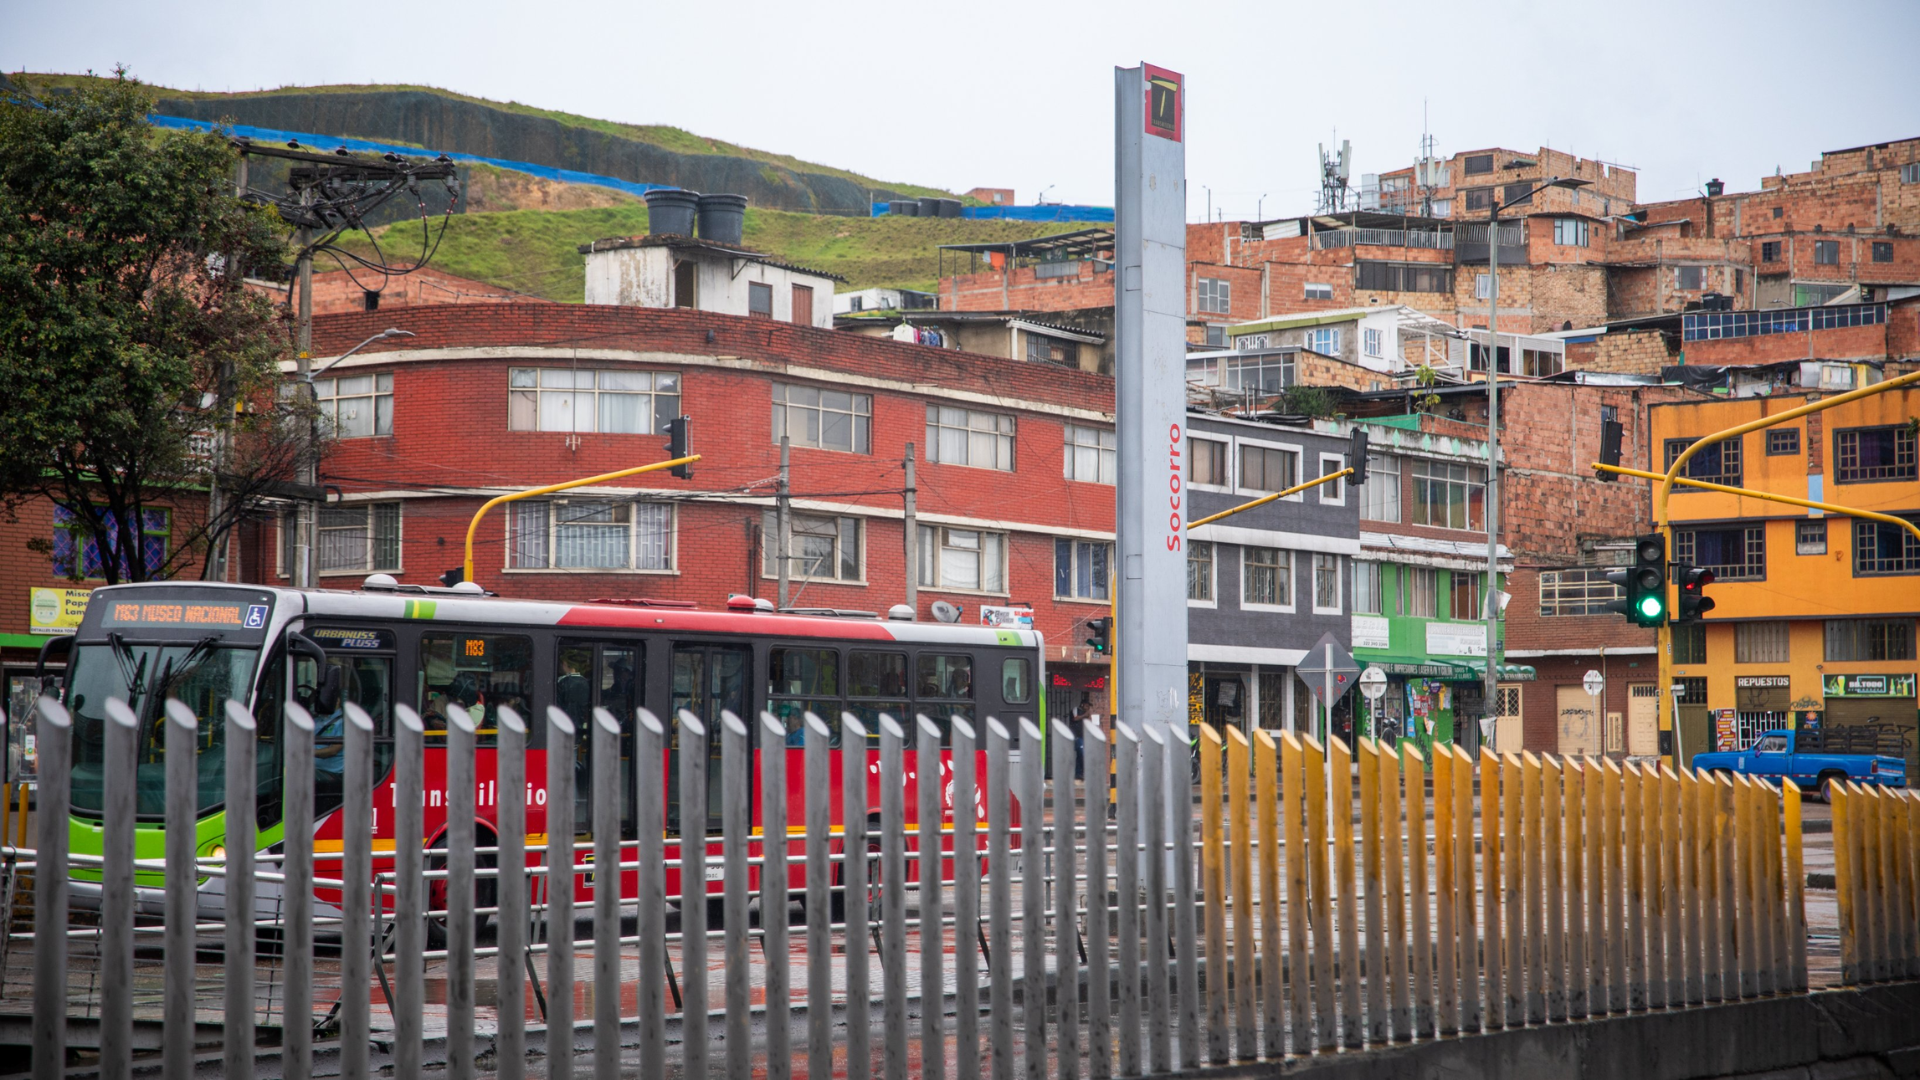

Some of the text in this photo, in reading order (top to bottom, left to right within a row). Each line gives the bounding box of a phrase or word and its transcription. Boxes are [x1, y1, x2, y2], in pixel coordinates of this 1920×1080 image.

[1166, 423, 1181, 552] Socorro
[114, 604, 243, 624] M83 MUSEO NACIONAL
[313, 629, 378, 639] URBANUSS
[341, 638, 381, 648] PLUSS
[465, 640, 485, 656] M83
[1738, 677, 1789, 687] REPUESTOS
